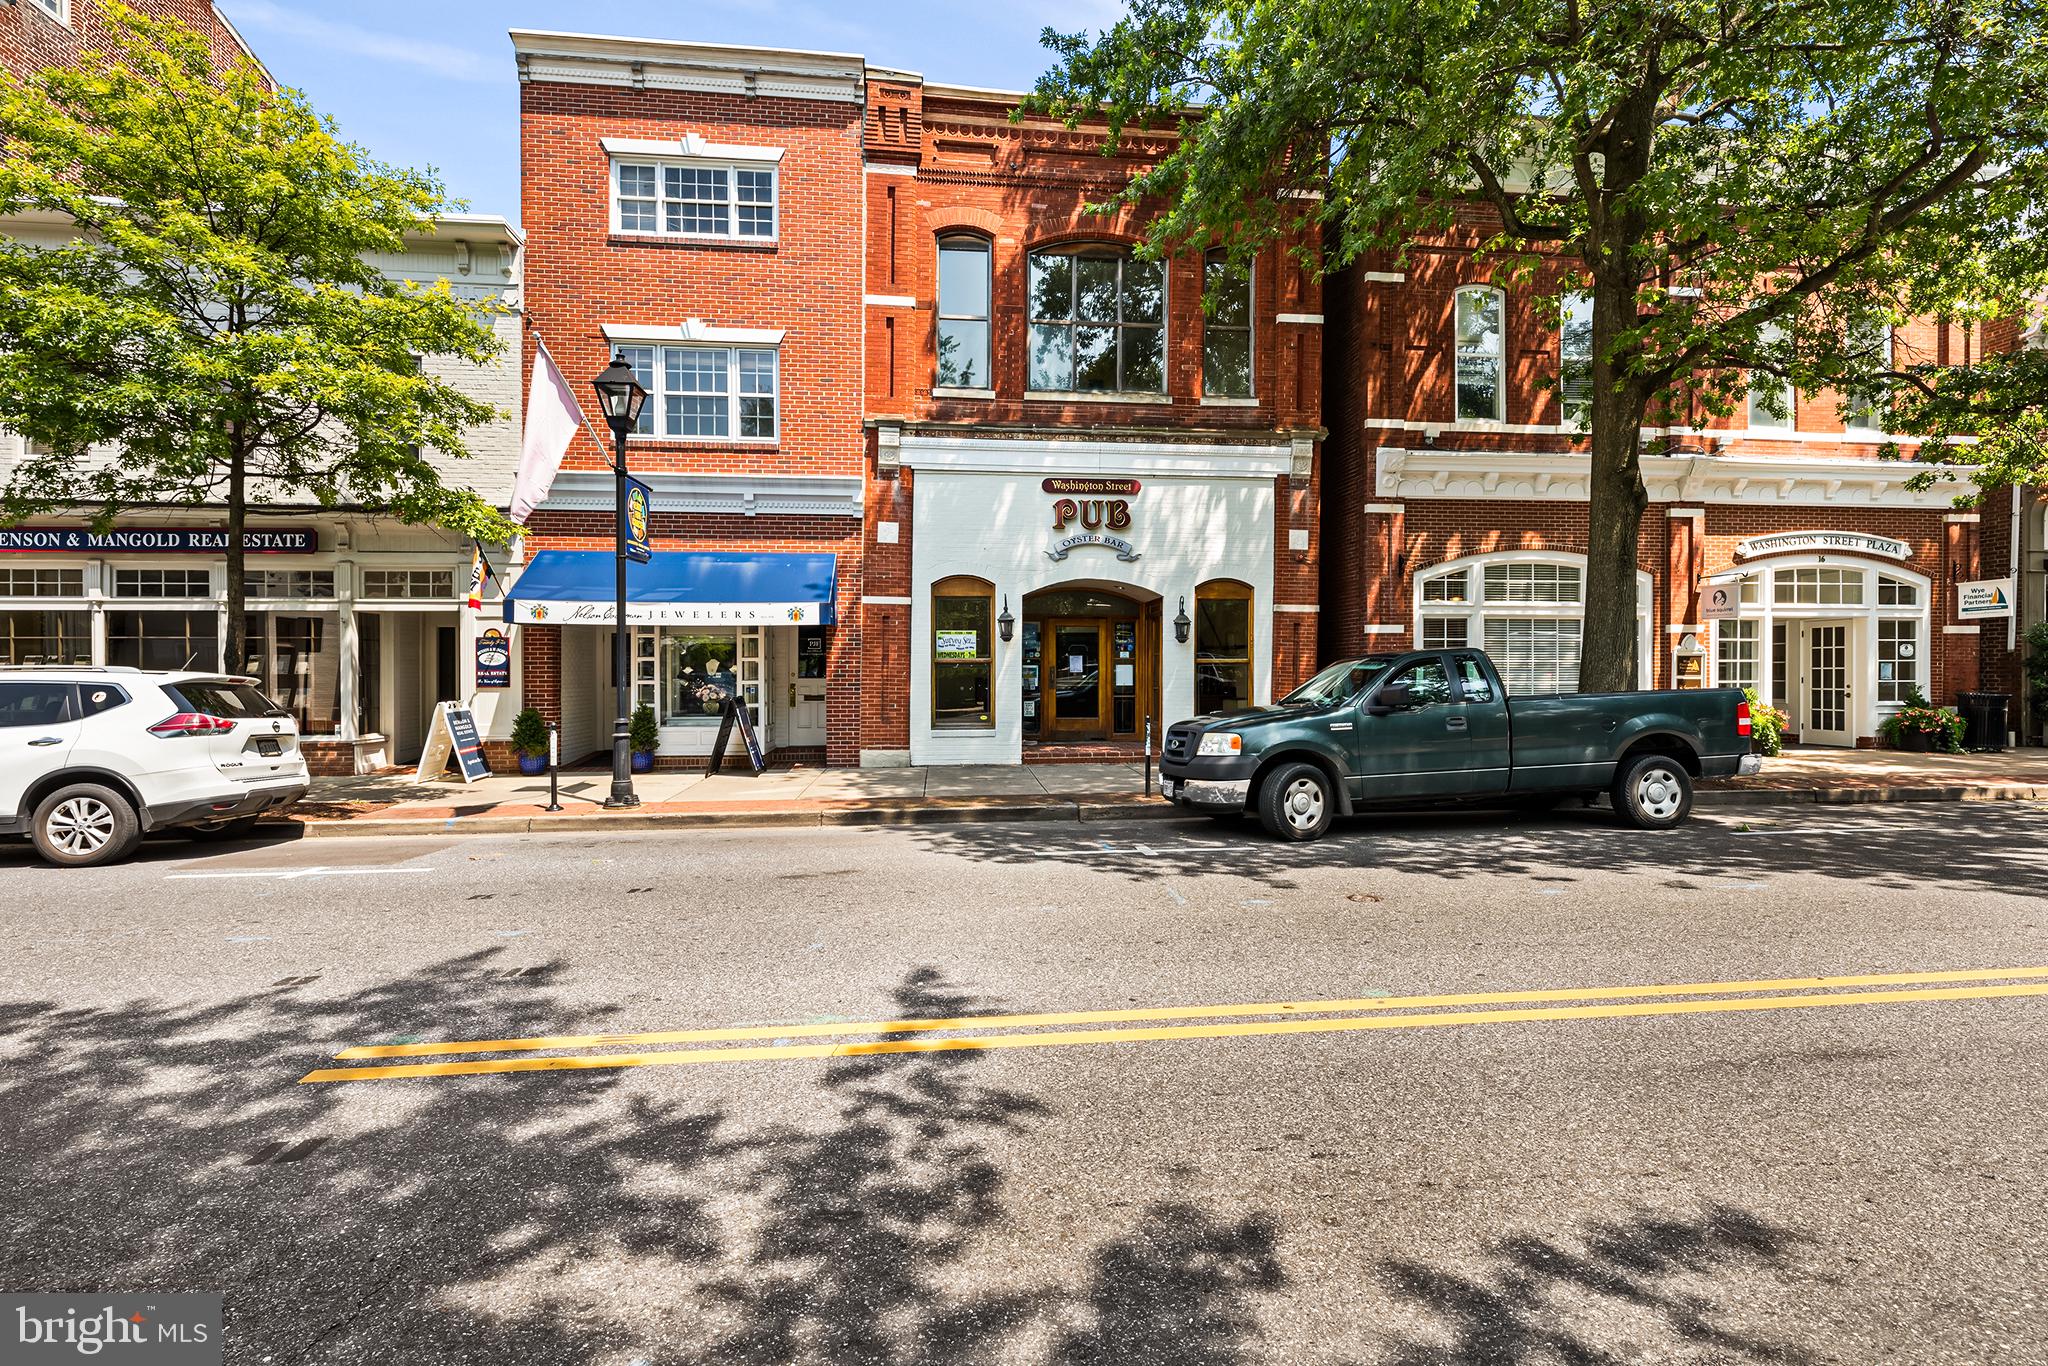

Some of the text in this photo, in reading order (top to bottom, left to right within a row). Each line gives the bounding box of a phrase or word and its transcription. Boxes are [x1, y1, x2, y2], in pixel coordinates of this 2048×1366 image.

[1051, 480, 1132, 492] Washington Street
[1052, 498, 1132, 530] PUB
[66, 533, 80, 547] &
[87, 533, 180, 547] MANGOLD
[242, 534, 306, 547] ESTATE
[1062, 535, 1124, 548] OYSTER BAR
[1749, 535, 1898, 554] WASHINGTON STREET PLAZA
[1817, 555, 1826, 563] 16
[563, 604, 601, 621] Nelson
[648, 610, 755, 620] JEWELERS
